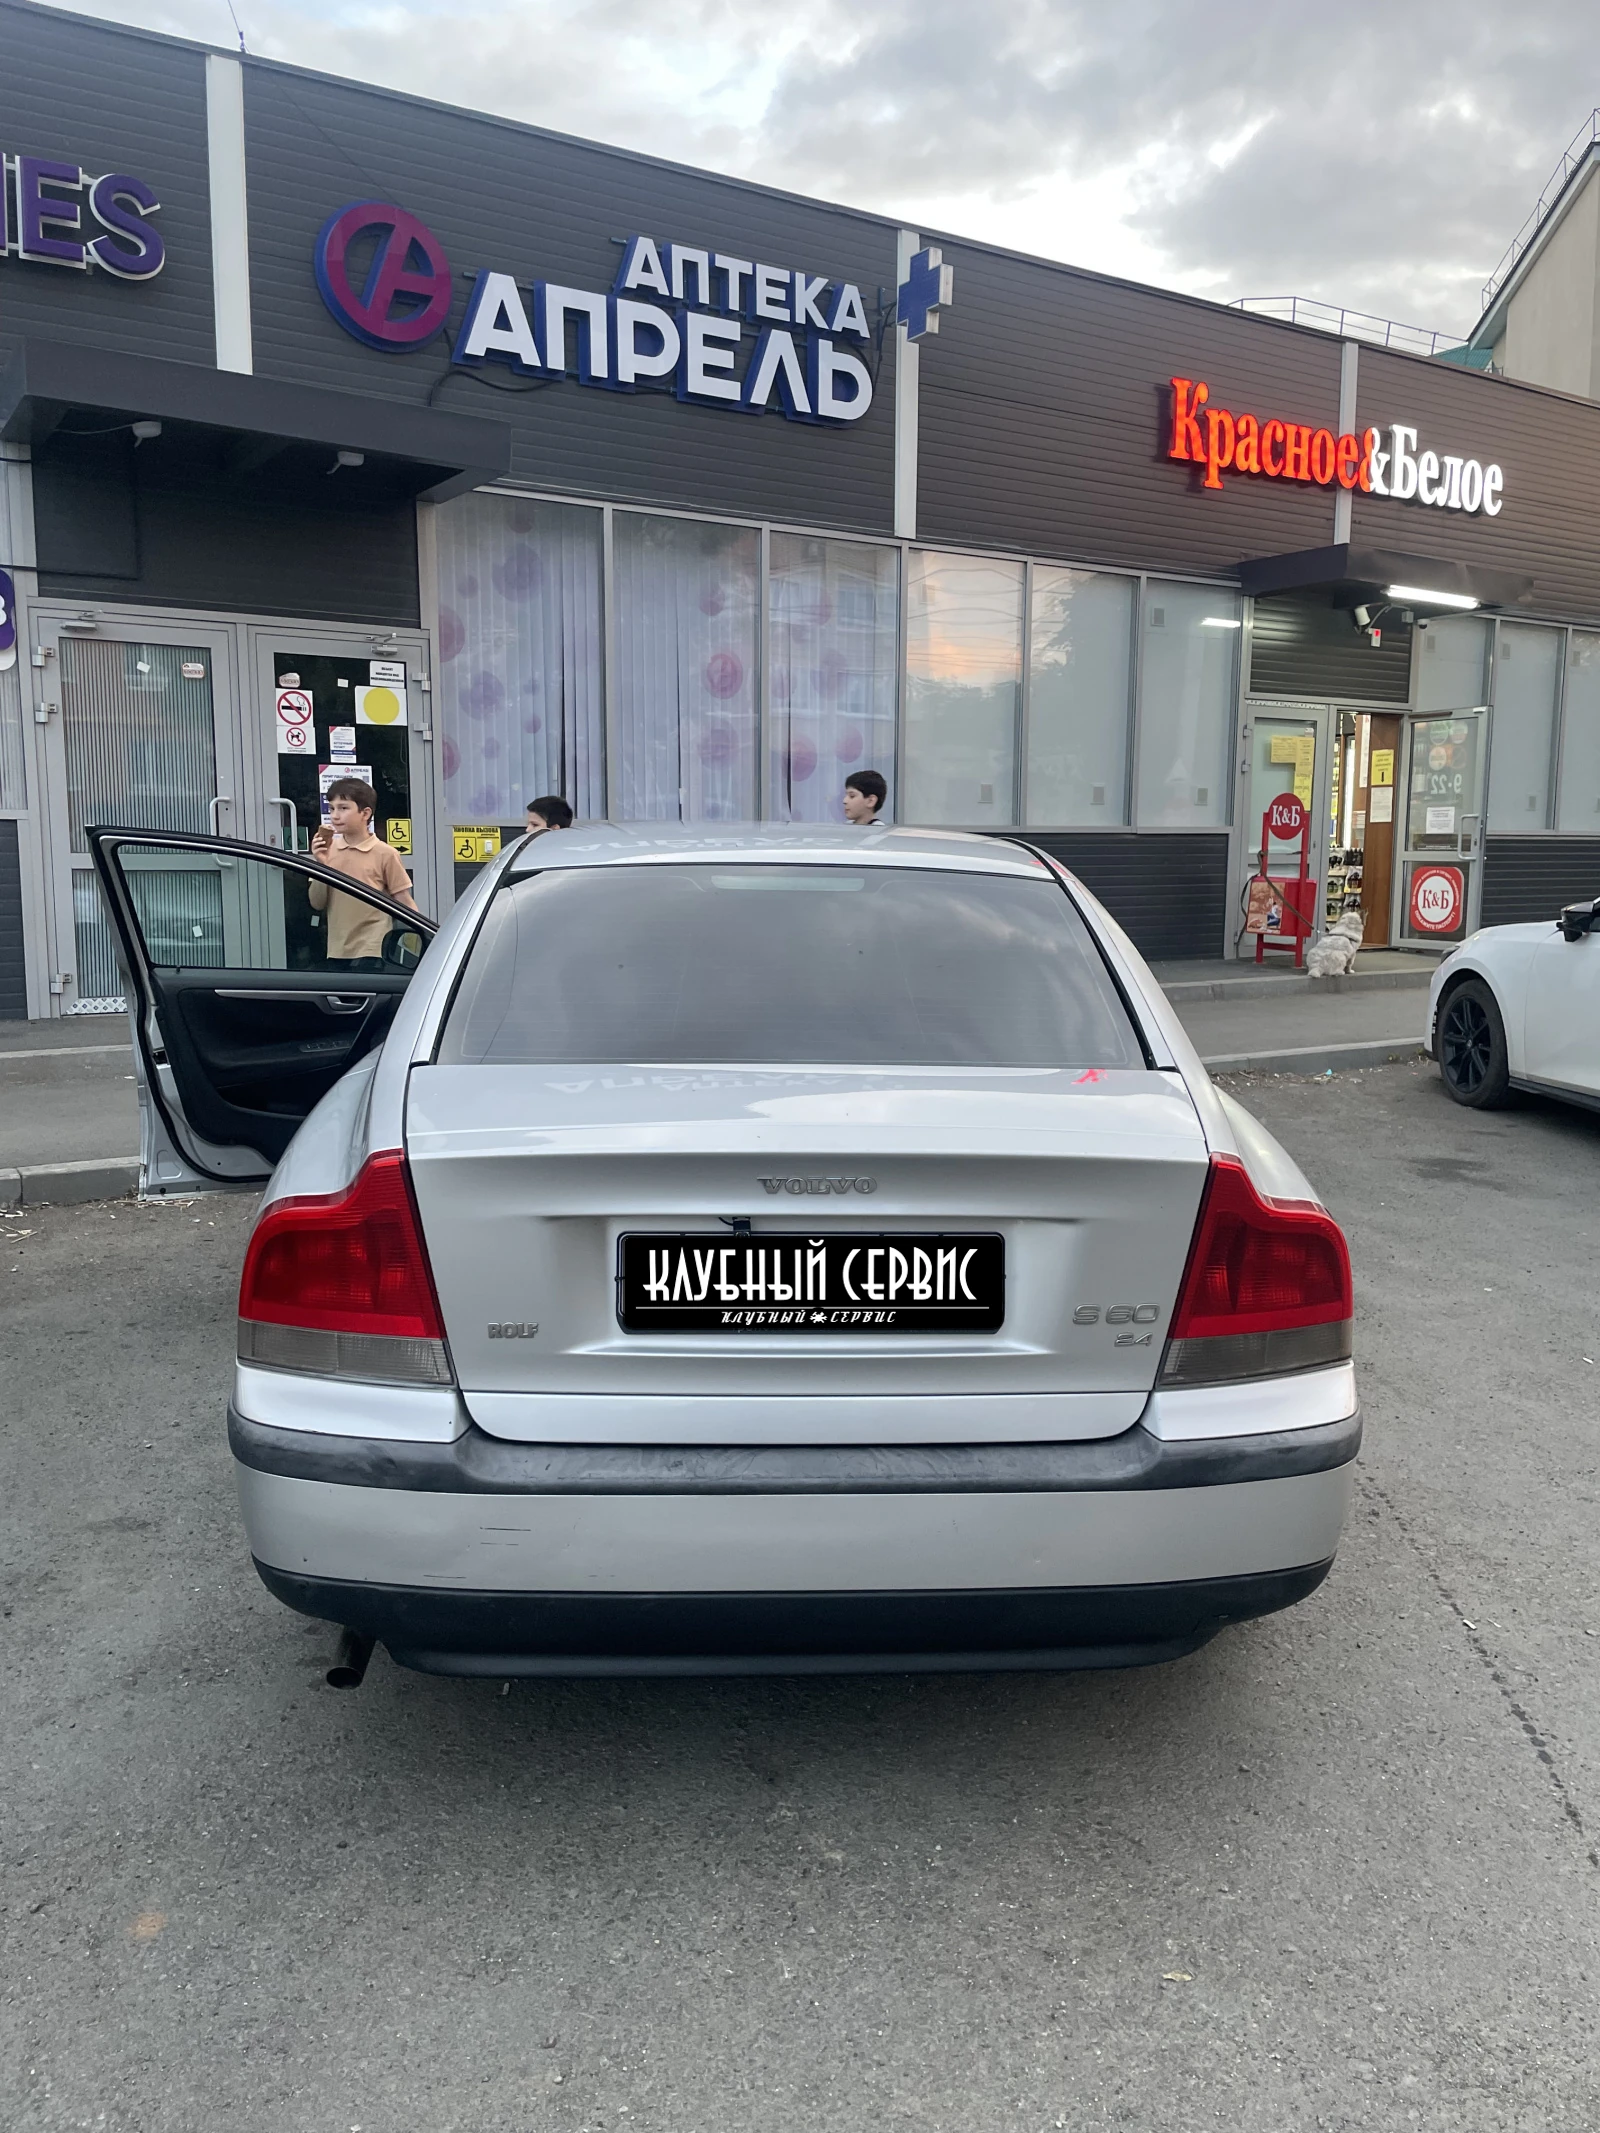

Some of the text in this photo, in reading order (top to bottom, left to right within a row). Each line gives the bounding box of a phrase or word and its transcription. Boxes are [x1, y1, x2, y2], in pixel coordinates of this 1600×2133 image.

[622, 236, 871, 339] АПТЕКА
[463, 271, 874, 421] АПРЕЛЬ
[757, 1176, 878, 1194] VOLVO
[488, 1321, 539, 1339] ROLF
